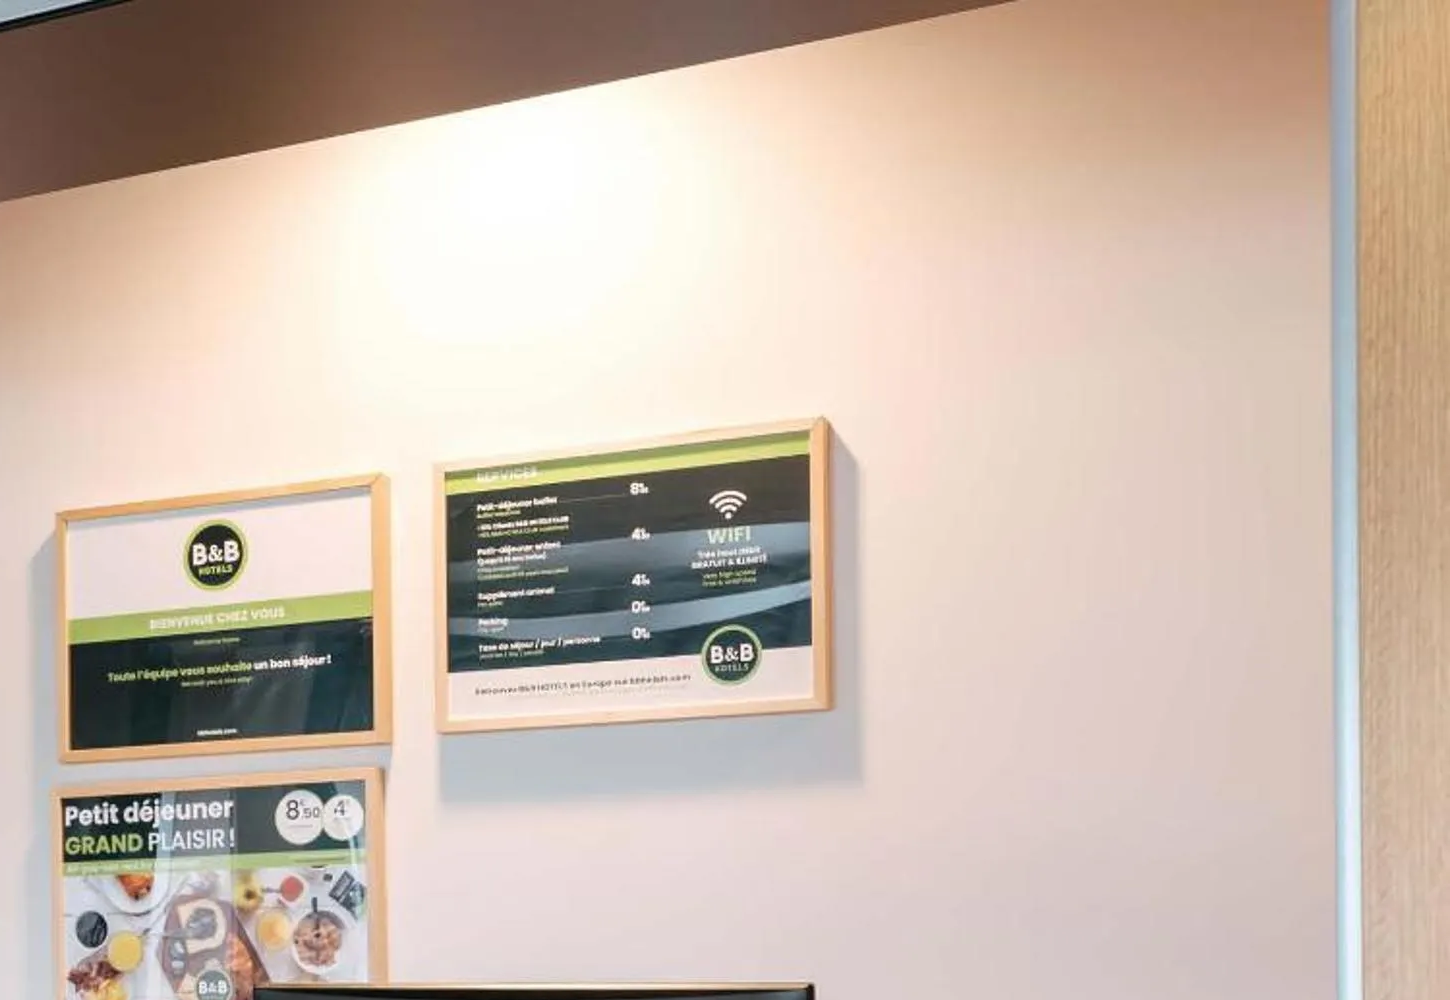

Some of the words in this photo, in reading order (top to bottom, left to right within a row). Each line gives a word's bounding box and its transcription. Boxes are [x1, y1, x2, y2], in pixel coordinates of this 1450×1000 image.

[707, 526, 751, 544] WIFI
[192, 540, 240, 567] B&B
[198, 563, 234, 577] HOTELS
[149, 613, 214, 630] BIENVENUE
[217, 609, 249, 624] CHEZ
[250, 605, 285, 621] VOUS
[710, 643, 754, 664] B&B
[180, 666, 205, 677] vous
[254, 661, 268, 671] un
[270, 658, 290, 669] bon
[65, 801, 118, 828] Petit
[123, 799, 235, 829] déjeuner
[65, 832, 143, 857] GRAND
[147, 829, 225, 851] PLAISIR
